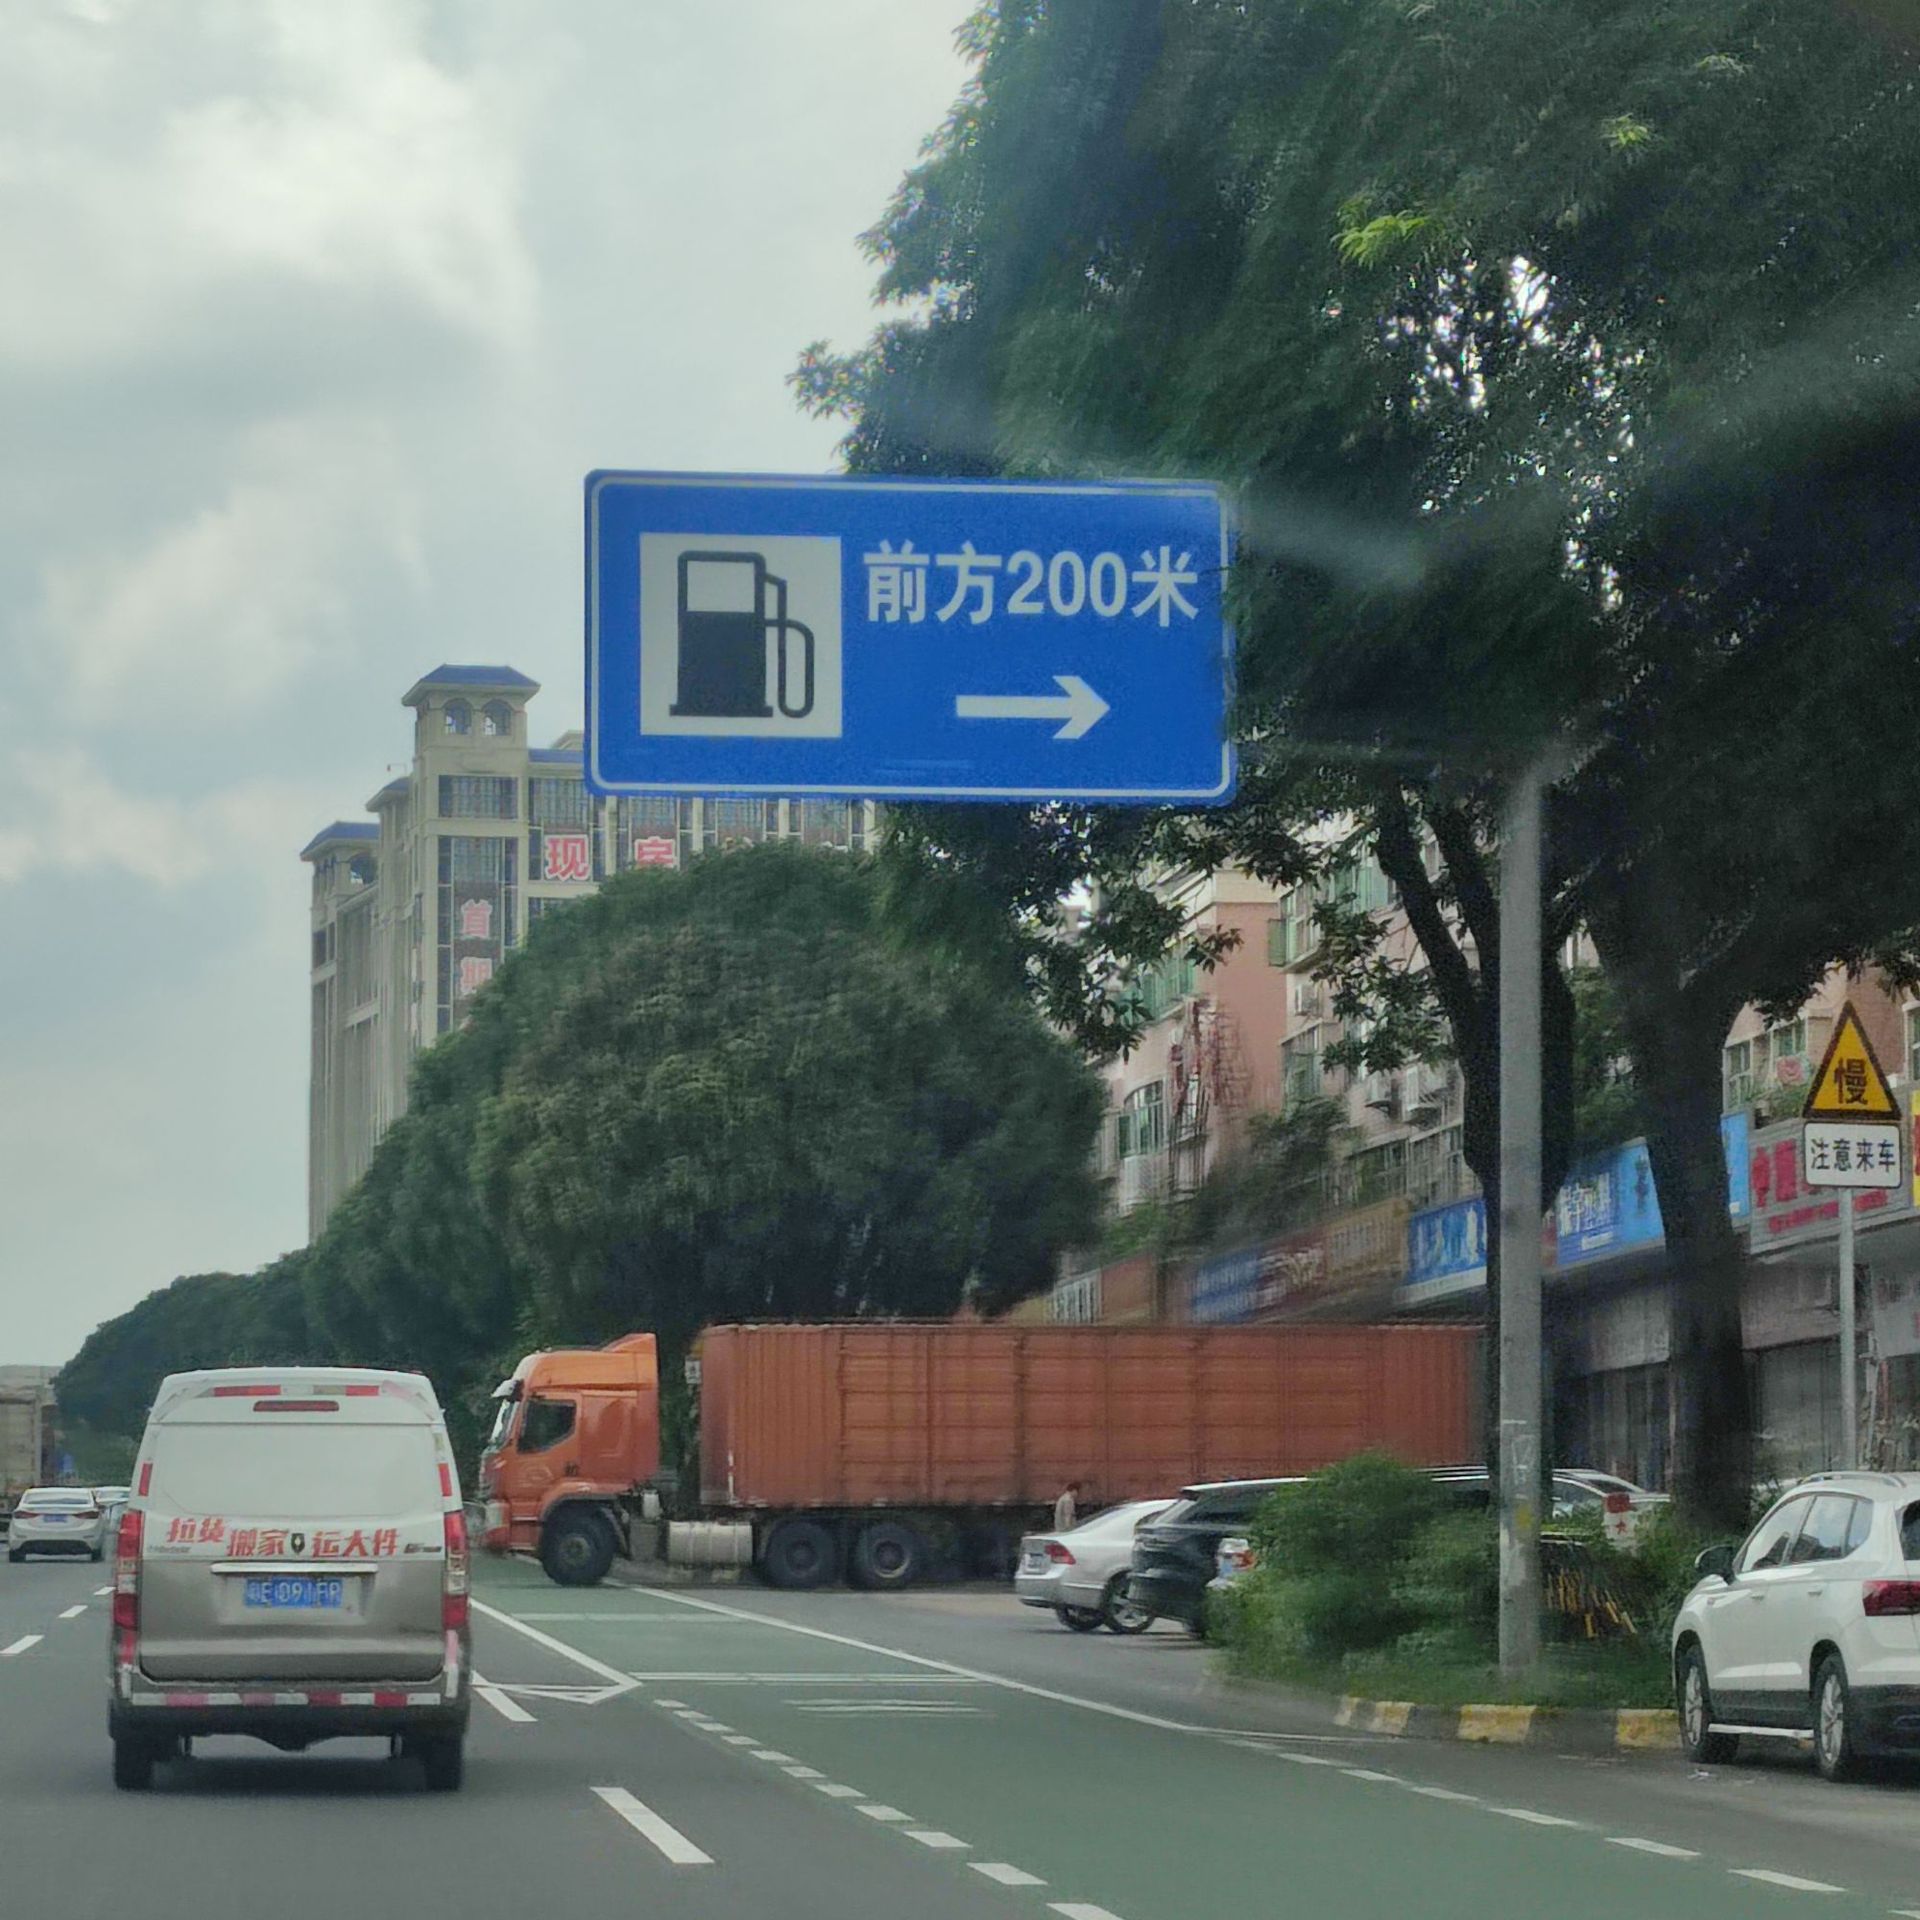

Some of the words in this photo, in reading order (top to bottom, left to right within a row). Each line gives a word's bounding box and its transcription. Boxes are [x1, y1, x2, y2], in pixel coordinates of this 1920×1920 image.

[863, 538, 1199, 628] 前方200米
[1833, 1057, 1869, 1105] 慢
[1810, 1138, 1896, 1172] 注意来车
